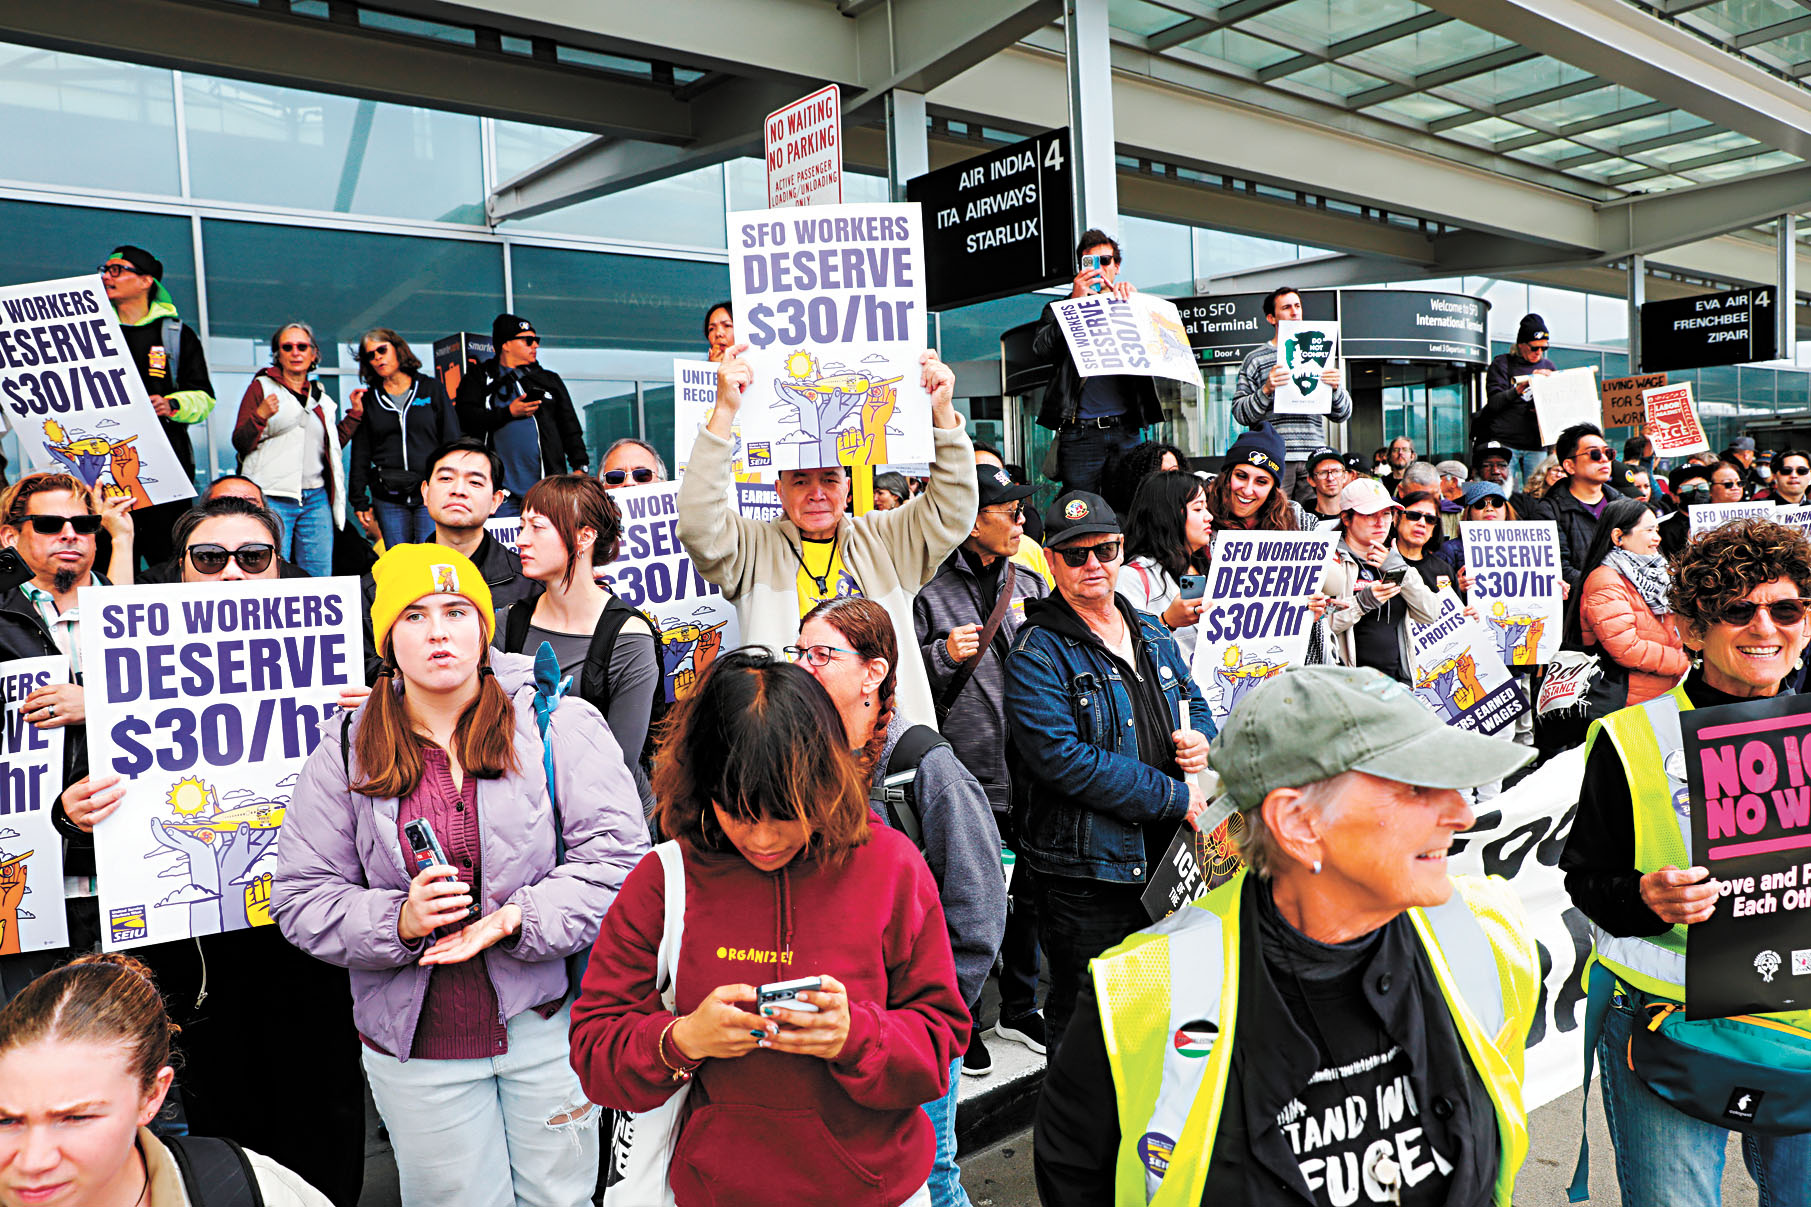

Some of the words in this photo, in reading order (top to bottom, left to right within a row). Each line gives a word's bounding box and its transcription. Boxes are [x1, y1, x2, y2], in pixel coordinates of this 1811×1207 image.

[770, 119, 784, 144] NO
[787, 96, 833, 136] WAITING
[769, 147, 783, 172] NO
[787, 124, 835, 165] PARKING
[1044, 138, 1064, 171] 4
[775, 174, 794, 192] ACTIVE
[797, 159, 832, 183] PASSENGER
[958, 167, 985, 191] AIR
[990, 151, 1036, 181] INDIA
[937, 207, 960, 230] ITA
[965, 184, 1037, 221] AIRWAYS
[741, 221, 786, 249] SFO
[793, 216, 910, 244] WORKERS
[966, 217, 1039, 253] STARLUX
[743, 247, 914, 295] DESERVE
[3, 289, 100, 323] WORKERS
[1193, 306, 1207, 318] to
[1209, 302, 1236, 317] SFO
[1430, 298, 1463, 313] Welcome
[1695, 299, 1720, 312] EVA
[1725, 295, 1749, 307] AIR
[1754, 290, 1771, 307] 4
[747, 294, 914, 350] $30/hr
[1060, 303, 1091, 348] WORKERS
[1077, 299, 1125, 369] DESERVE
[1202, 317, 1259, 333] Terminal
[1416, 313, 1465, 329] International
[1673, 312, 1749, 331] FRENCHBEE
[1707, 329, 1749, 343] ZIPAIR
[0, 319, 119, 369] ESERVE
[1080, 351, 1098, 370] SFO
[1214, 350, 1233, 358] Door
[1, 366, 131, 418] $30/hr
[683, 387, 718, 403] RECO
[1603, 379, 1634, 393] LIVING
[1635, 376, 1665, 388] WAGE
[1611, 395, 1632, 408] FOR
[1662, 426, 1690, 441] ICE
[1696, 510, 1716, 524] SFO
[1221, 541, 1254, 562] SFO
[1256, 541, 1329, 562] WORKERS
[1469, 528, 1491, 542] SFO
[1494, 528, 1552, 542] WORKERS
[1471, 545, 1555, 568] DESERVE
[1212, 565, 1323, 600] DESERVE
[1474, 571, 1556, 599] $30/hr
[102, 602, 169, 639] SFO
[182, 594, 344, 634] WORKERS
[1206, 600, 1309, 644] $30/hr
[1418, 612, 1466, 650] PROFITS
[104, 633, 348, 704] DESERVE
[1474, 686, 1516, 721] EARNED
[1481, 699, 1523, 732] WAGES
[1700, 740, 1779, 800] NO
[1706, 793, 1767, 839] NO
[1760, 865, 1798, 892] and
[1732, 894, 1777, 917] Each
[113, 927, 146, 942] SEIU
